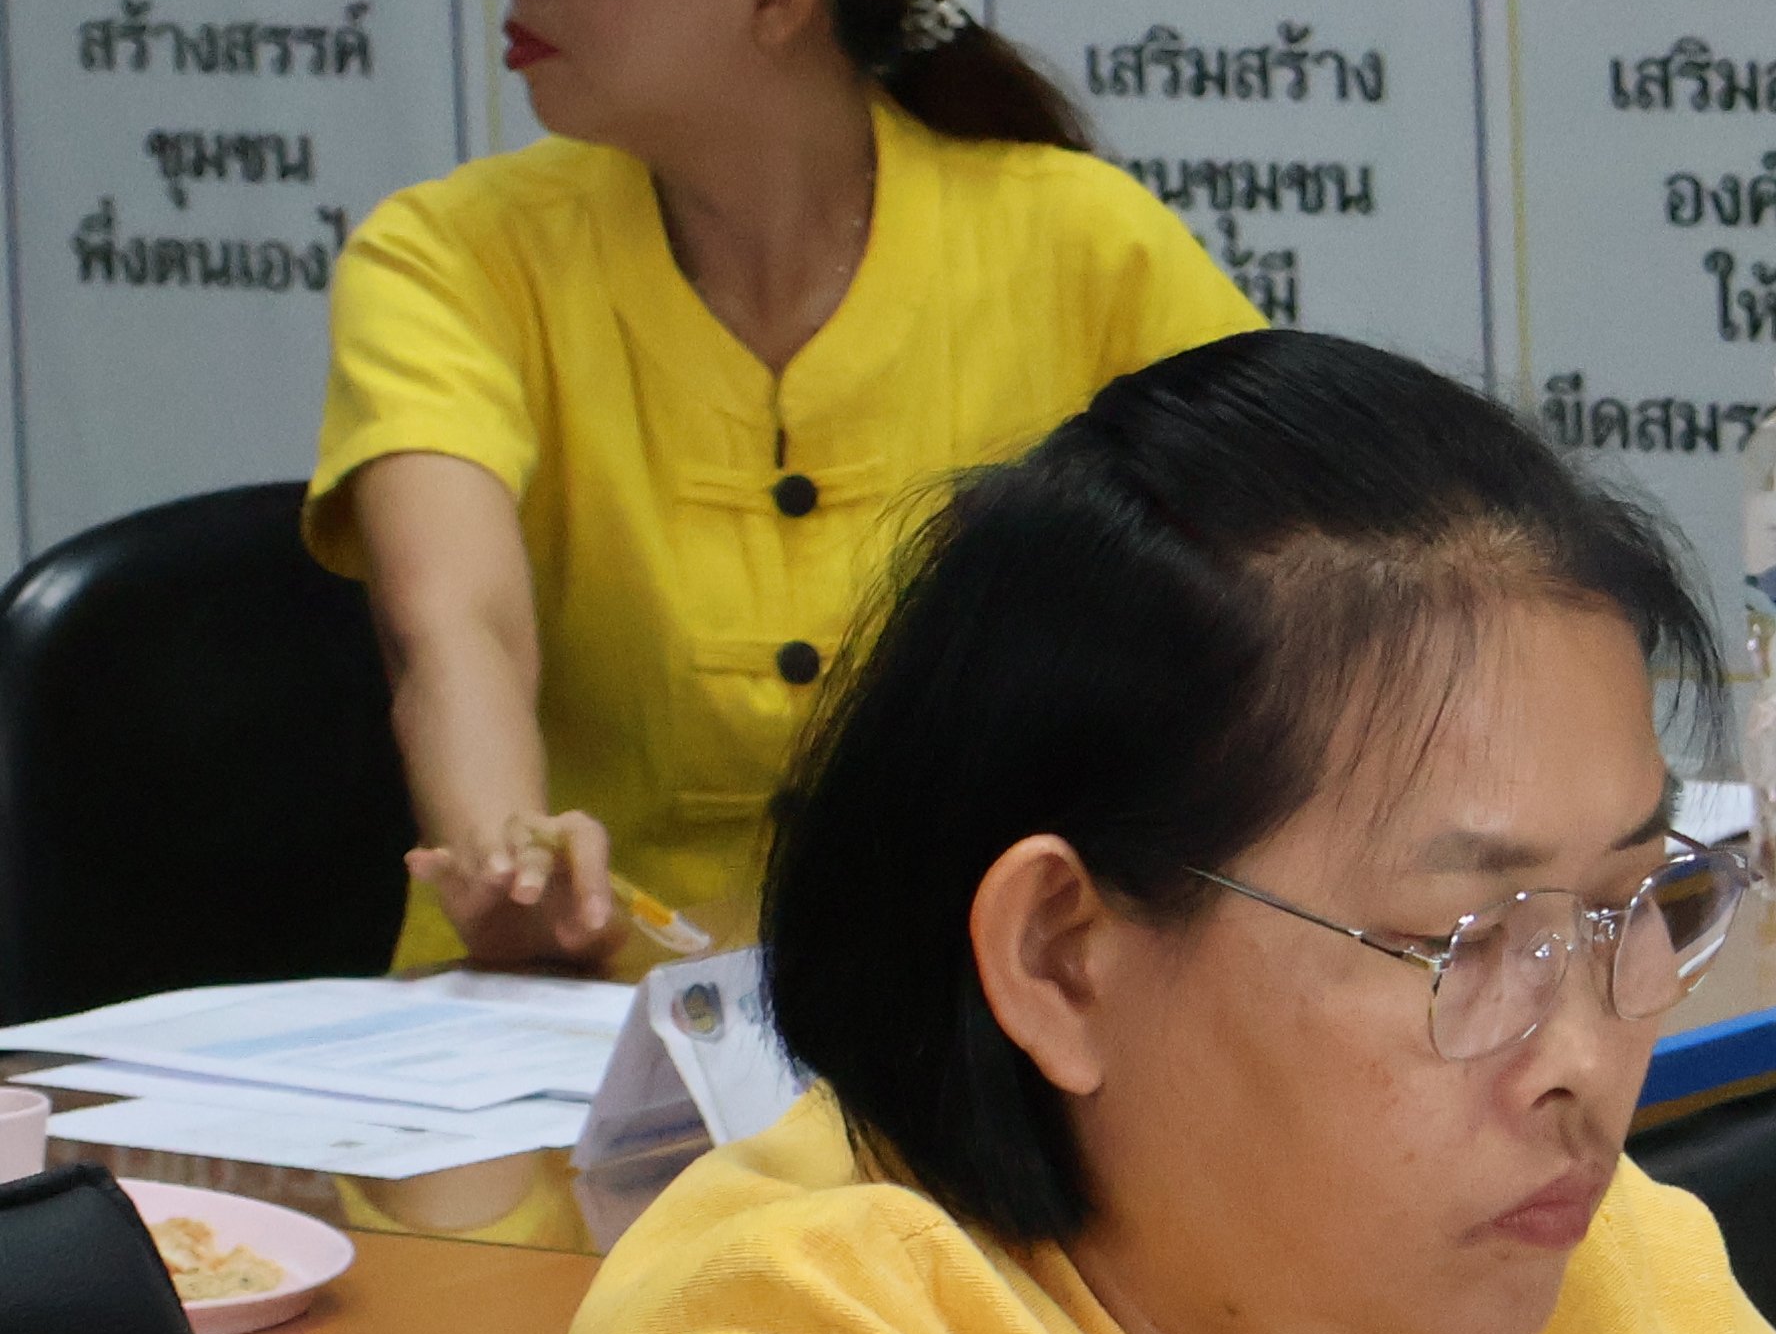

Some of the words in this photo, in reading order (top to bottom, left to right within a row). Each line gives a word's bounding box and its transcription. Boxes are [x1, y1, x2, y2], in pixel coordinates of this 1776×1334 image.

[1085, 20, 1384, 104] เสริมสร้าง
[146, 128, 315, 210] ชุมชน
[1127, 157, 1375, 242] นชุมชน
